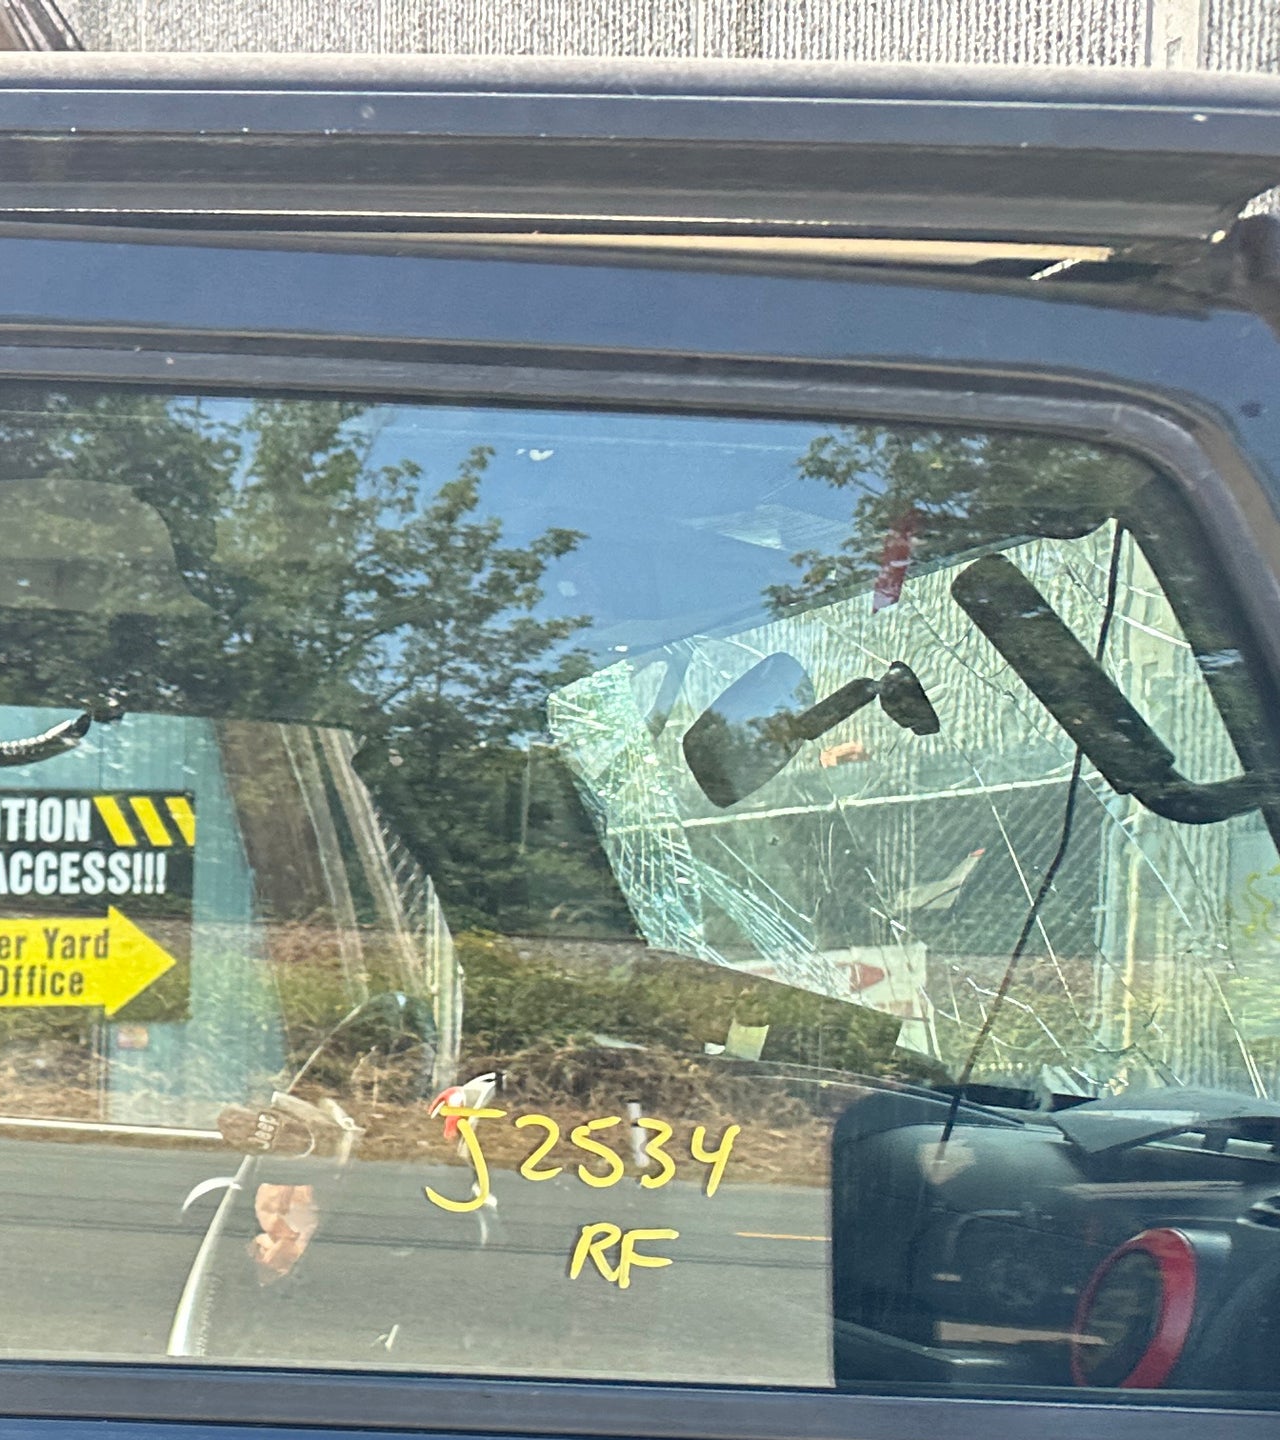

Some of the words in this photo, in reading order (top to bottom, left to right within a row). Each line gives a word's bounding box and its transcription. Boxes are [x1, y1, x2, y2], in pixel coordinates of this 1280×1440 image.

[42, 927, 110, 960] Yard
[425, 1105, 742, 1213] J2534
[569, 1222, 680, 1289] RF
